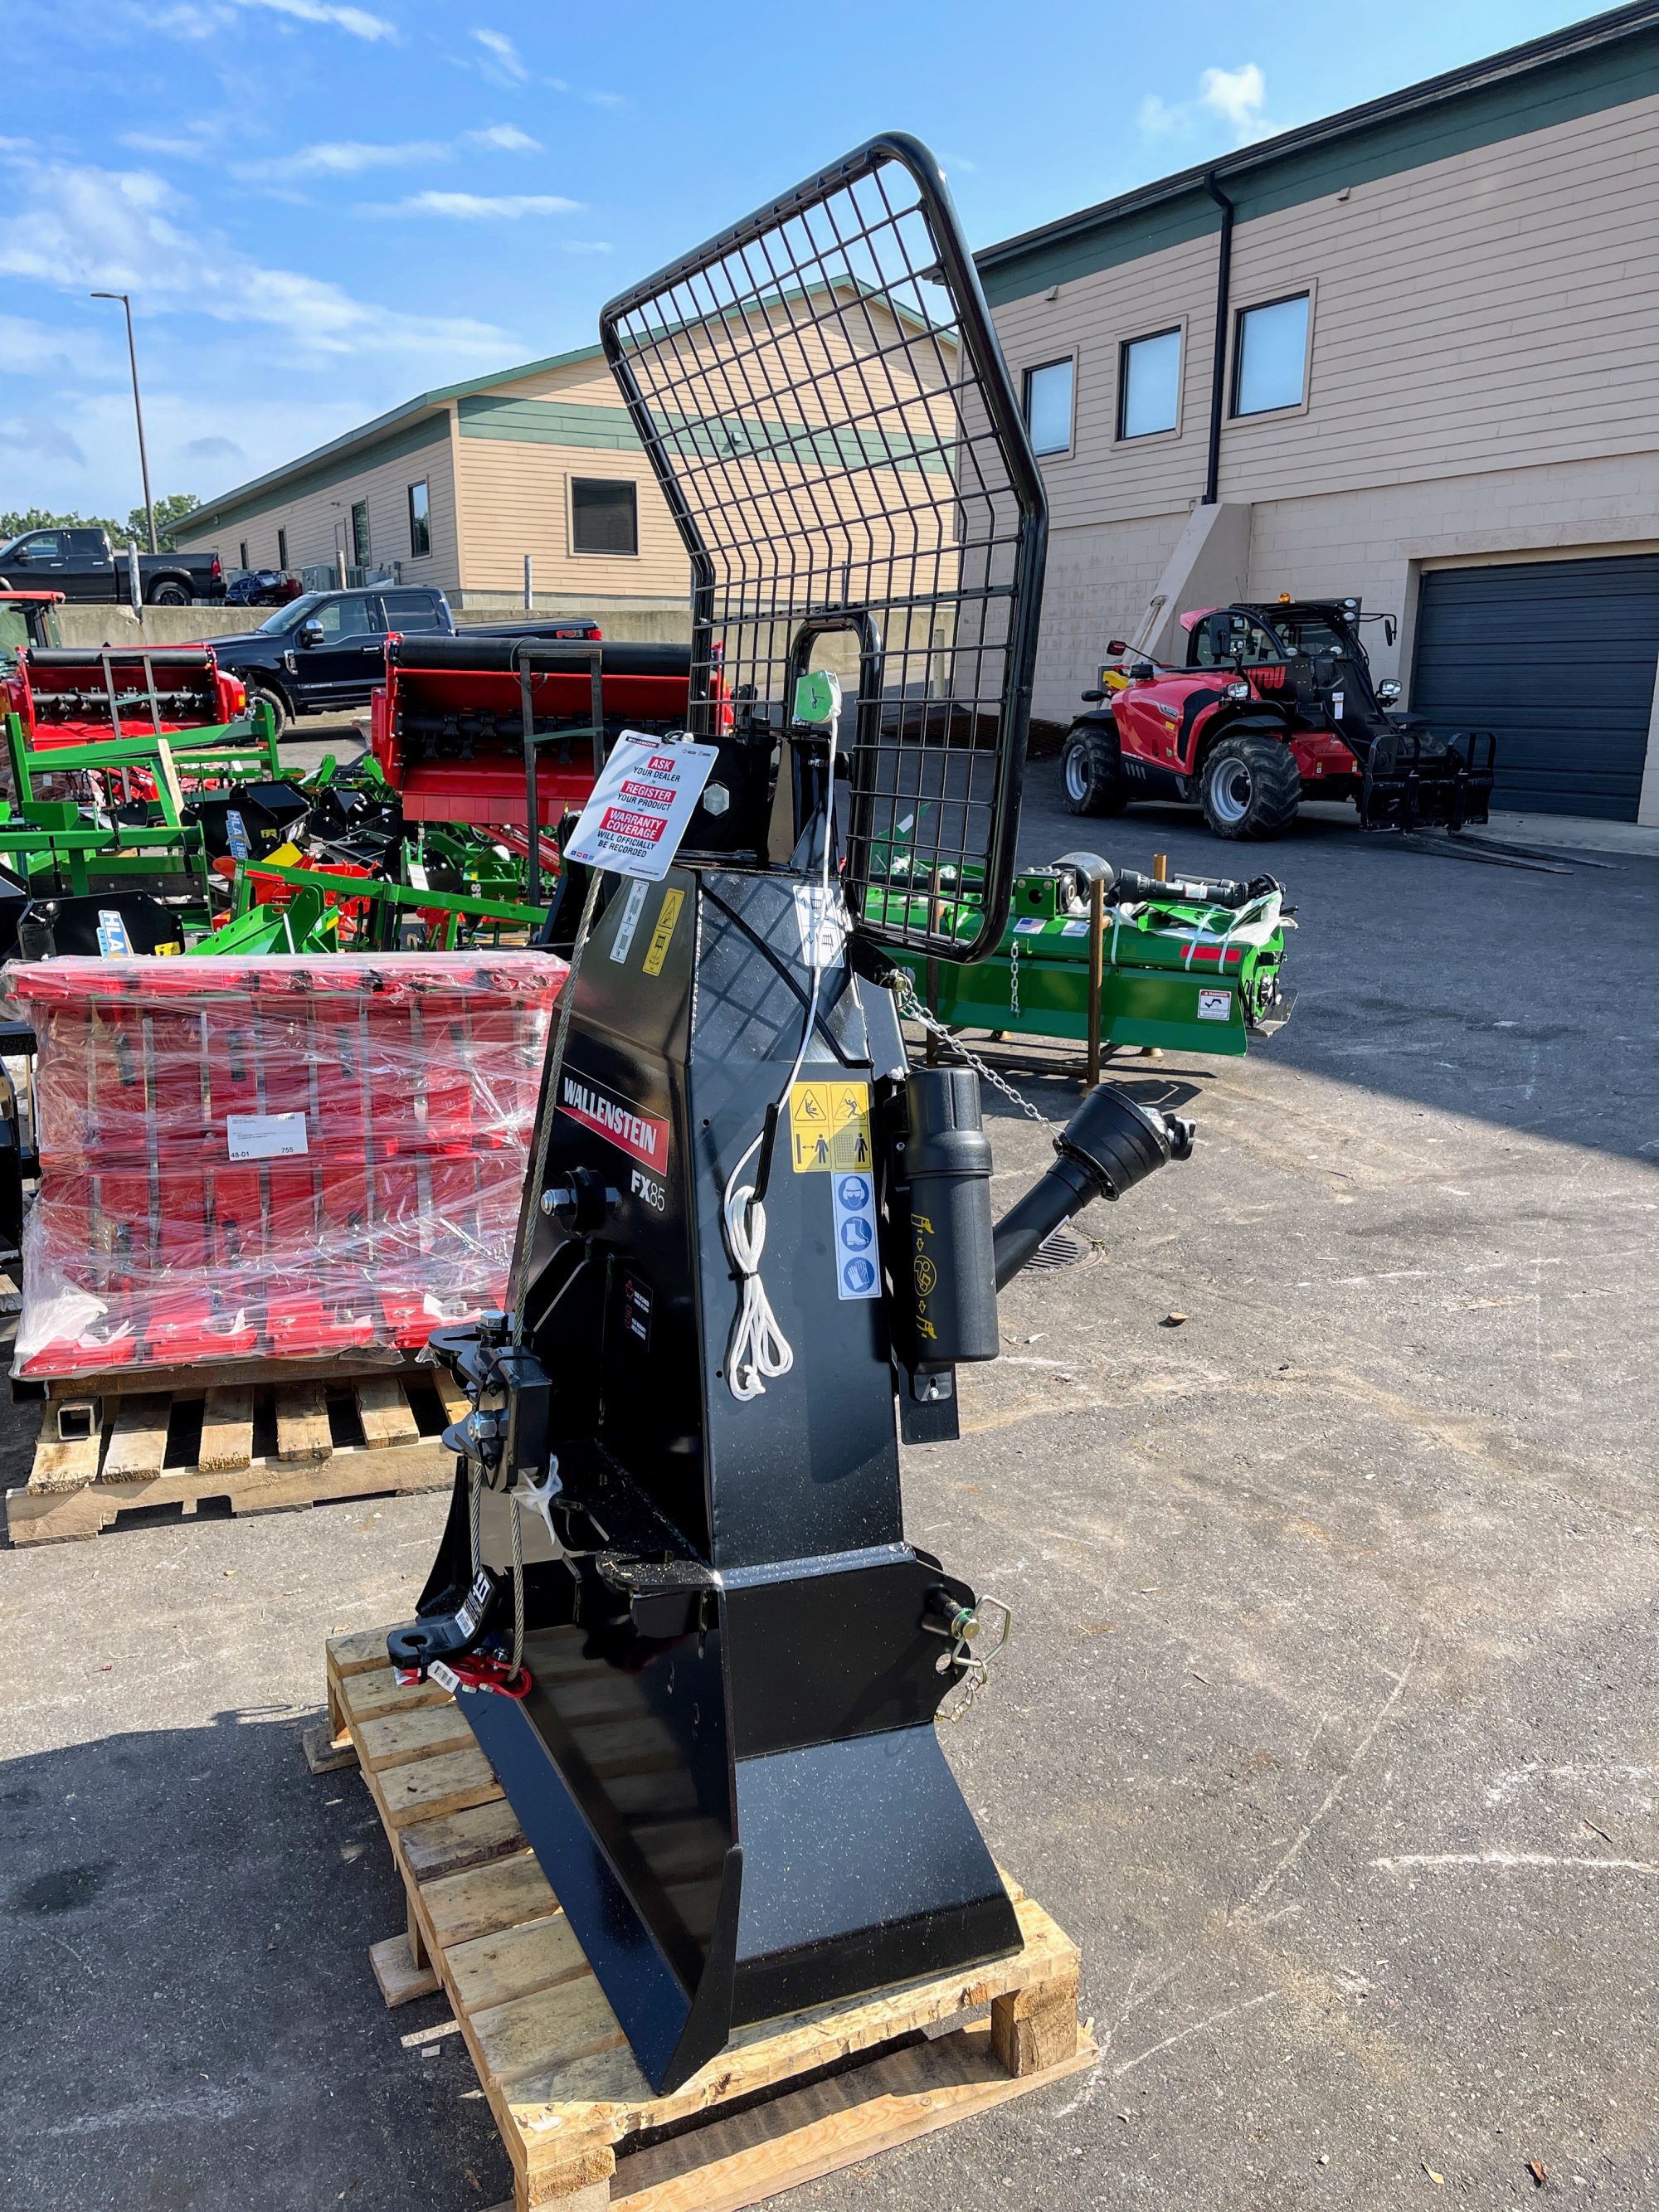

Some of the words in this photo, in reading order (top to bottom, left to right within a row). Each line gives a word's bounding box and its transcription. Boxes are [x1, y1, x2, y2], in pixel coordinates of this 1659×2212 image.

[633, 766, 653, 776] YOUR
[653, 771, 681, 782] DEALER
[651, 759, 672, 771] ASK
[625, 783, 672, 801] REGISTER
[617, 793, 637, 805] YOUR
[638, 798, 671, 811] PRODUCT
[230, 812, 242, 834] HLA
[610, 809, 663, 829] WARRANTY
[606, 819, 657, 839] COVERAGE
[597, 830, 615, 840] WILL
[616, 835, 656, 849] OFFICIALLY
[597, 839, 609, 848] BE
[609, 843, 647, 858] RECORDED
[103, 912, 124, 952] HLA
[563, 1077, 657, 1155] WALLENSTEIN
[630, 1169, 665, 1212] FX85
